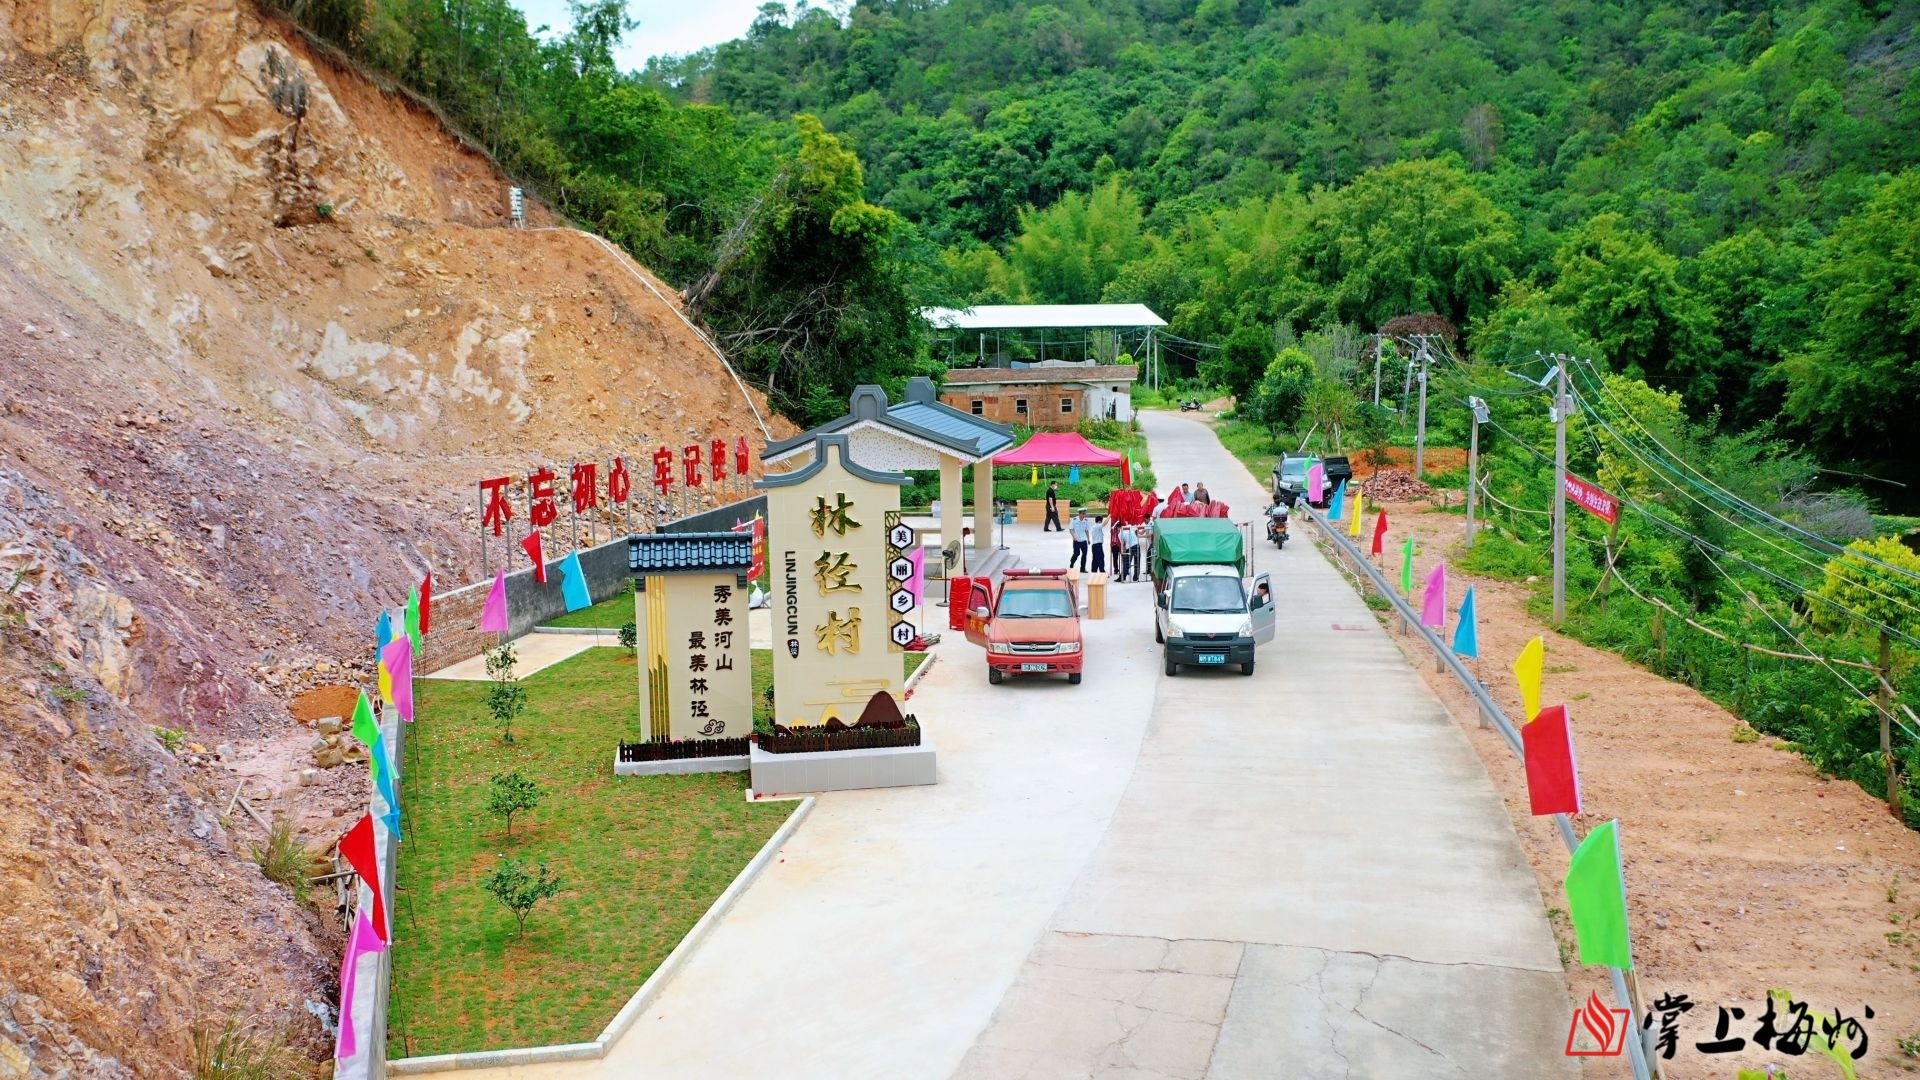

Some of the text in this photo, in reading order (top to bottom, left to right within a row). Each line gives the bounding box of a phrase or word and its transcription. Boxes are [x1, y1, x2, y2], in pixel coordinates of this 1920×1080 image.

[480, 456, 631, 537] 不忘初心
[784, 550, 799, 636] LINJINGCUN
[808, 492, 863, 656] 林径村
[895, 530, 910, 641] 美丽乡村
[713, 584, 734, 672] 秀美河山
[688, 631, 710, 718] 最美林径
